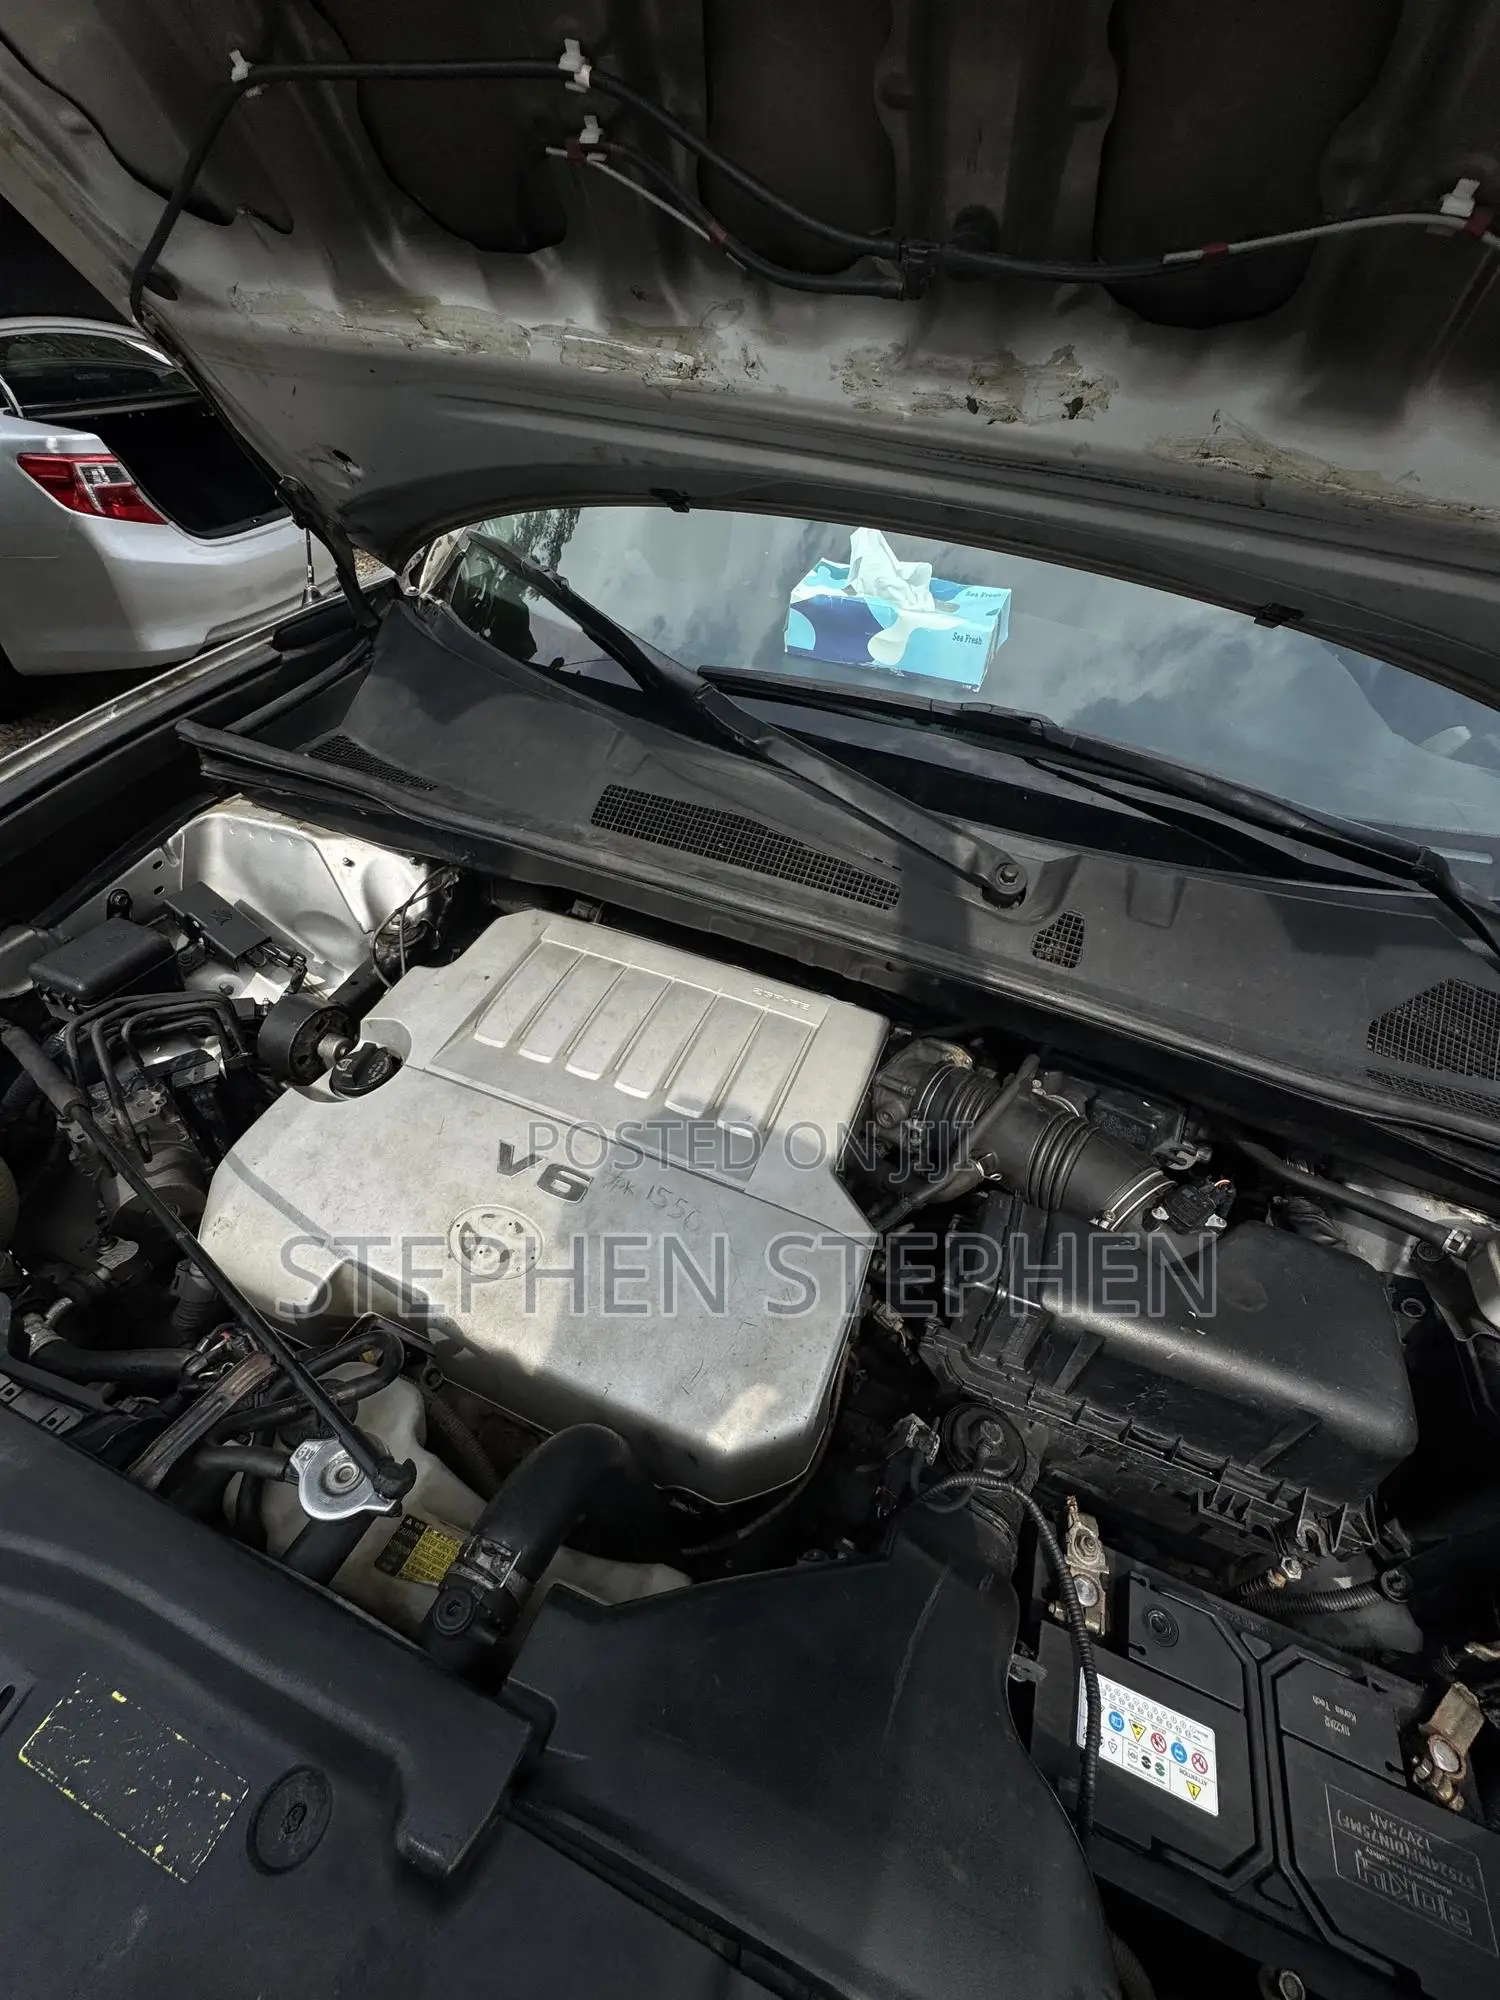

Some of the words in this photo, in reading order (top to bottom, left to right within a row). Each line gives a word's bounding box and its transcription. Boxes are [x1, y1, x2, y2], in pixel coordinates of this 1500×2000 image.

[952, 631, 964, 642] Sea
[965, 634, 983, 645] Fresh
[497, 1139, 594, 1203] V6
[1312, 1695, 1331, 1711] Tech
[1335, 1706, 1357, 1724] Korea
[1370, 1811, 1433, 1853] 12V75Ah
